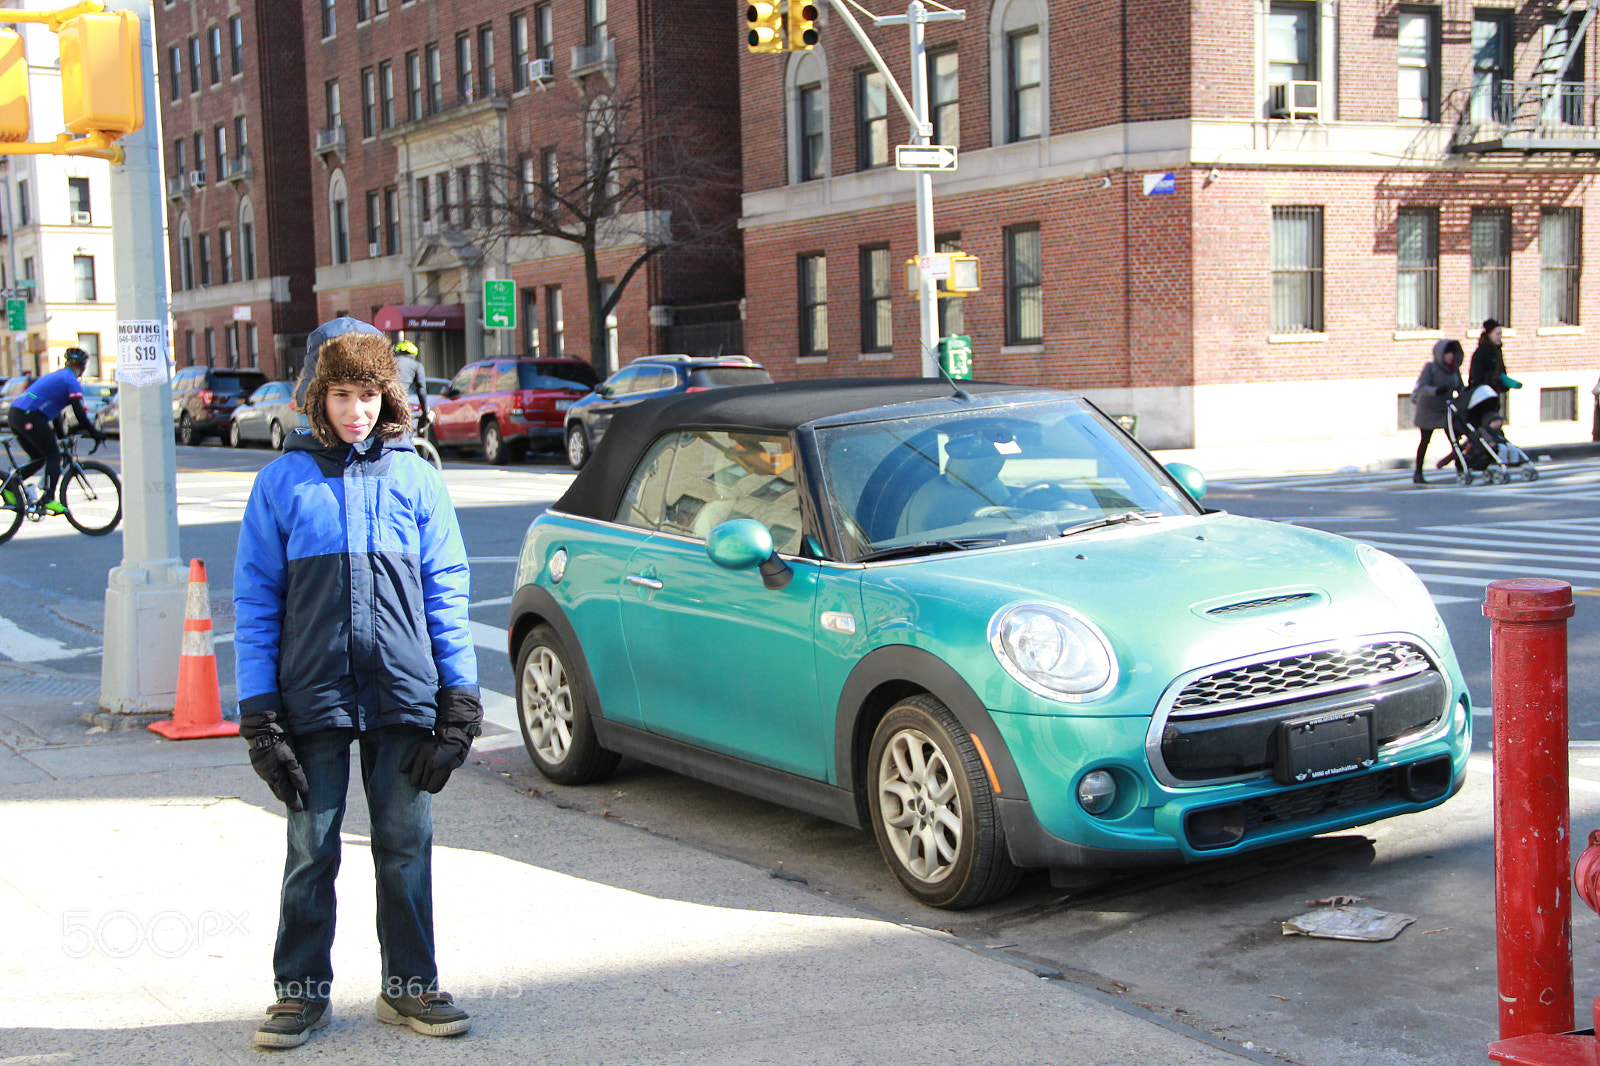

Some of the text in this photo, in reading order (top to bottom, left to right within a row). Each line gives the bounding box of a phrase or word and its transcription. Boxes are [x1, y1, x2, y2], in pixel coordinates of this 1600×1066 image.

[119, 325, 160, 334] MOVING
[135, 345, 156, 361] $19
[1331, 765, 1358, 774] Manhattan
